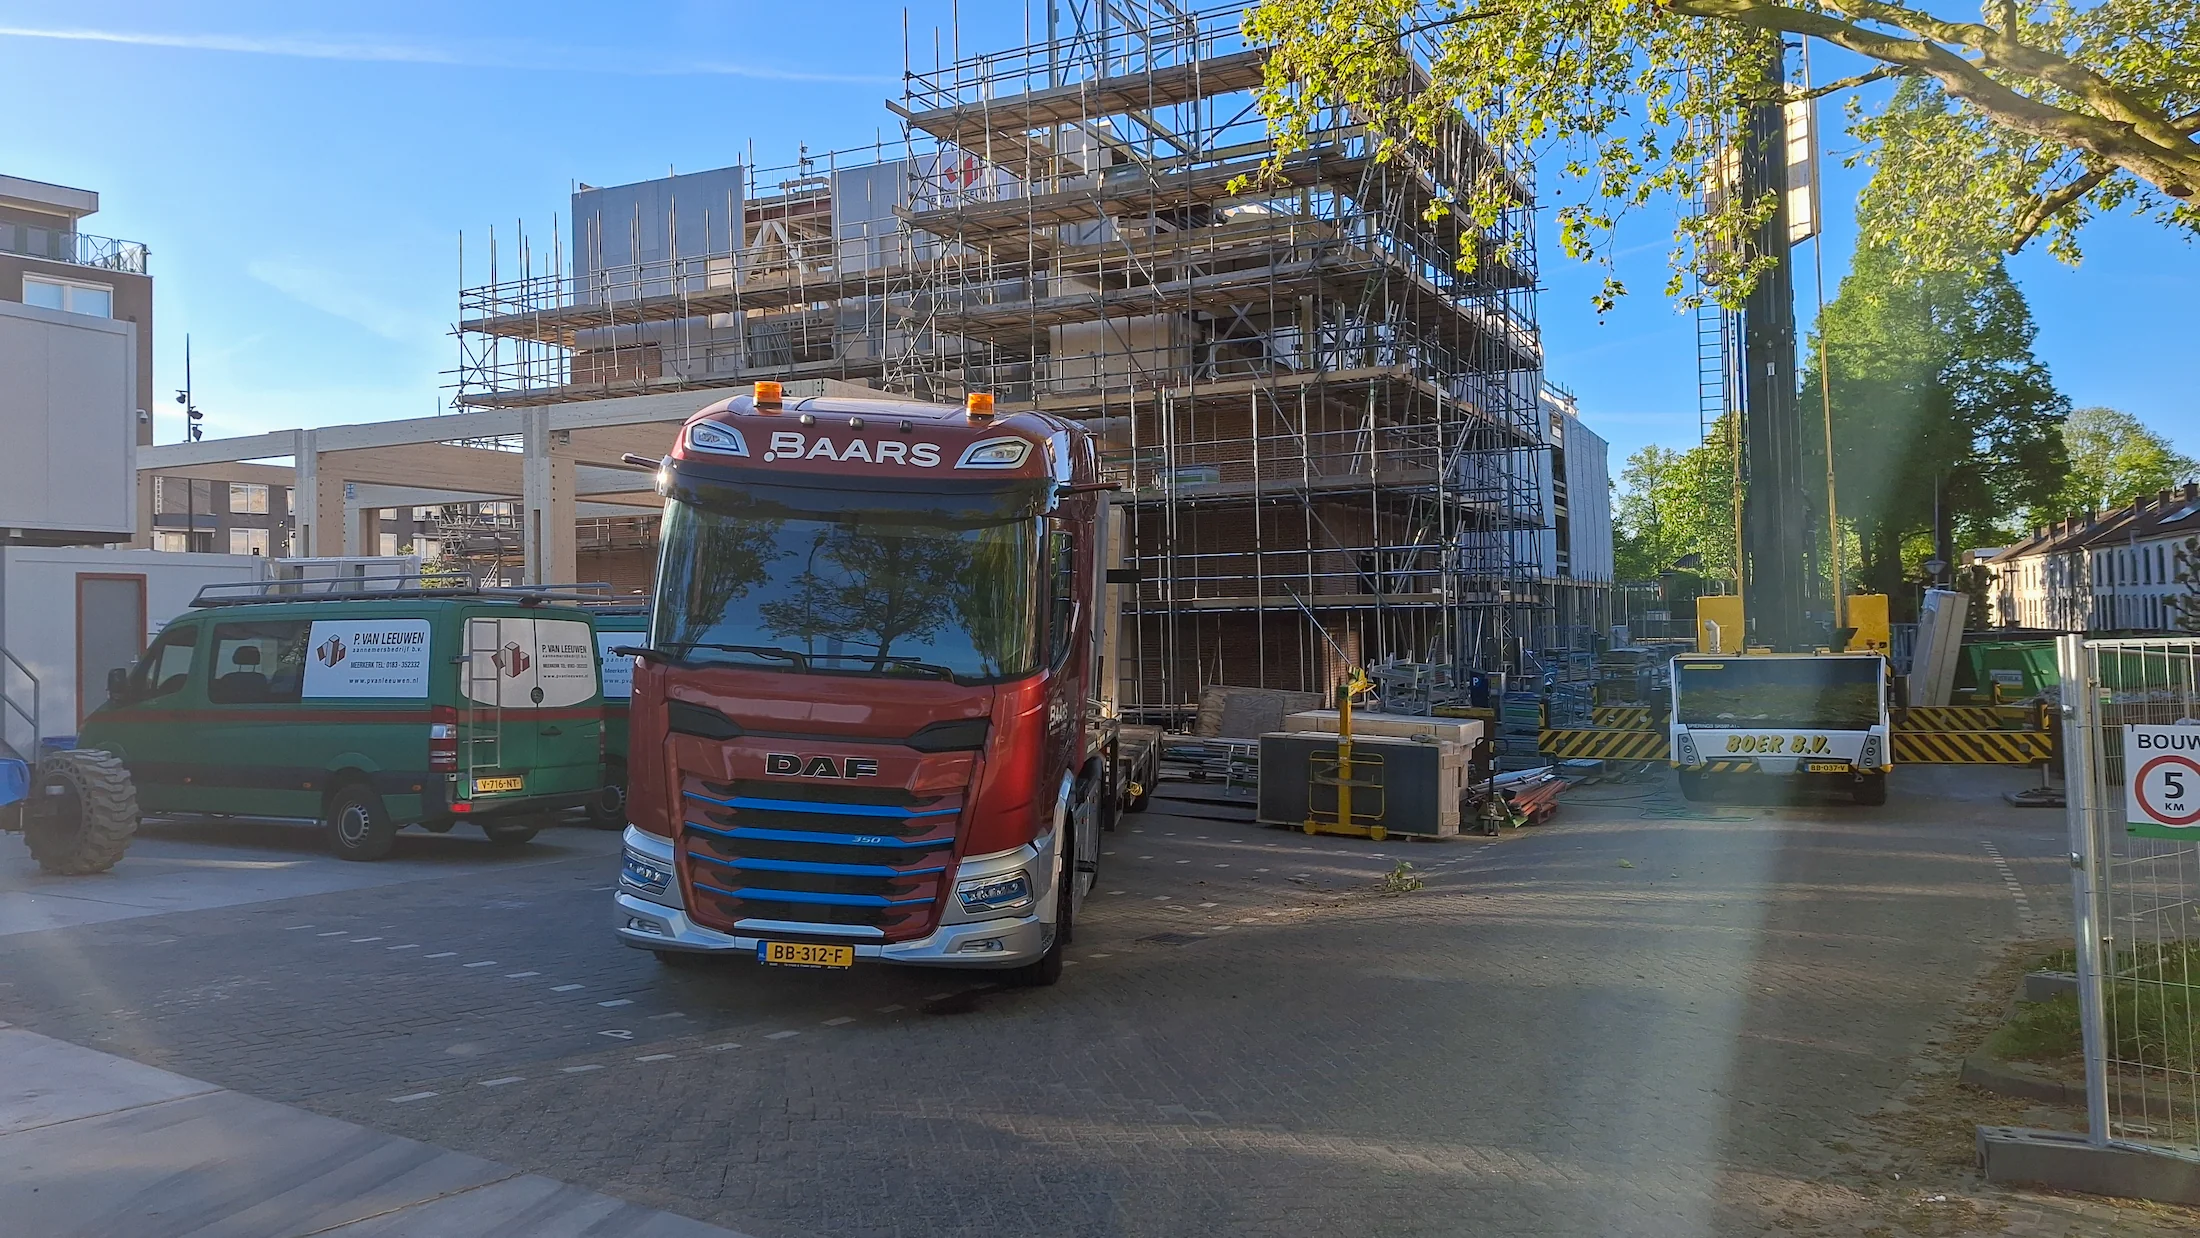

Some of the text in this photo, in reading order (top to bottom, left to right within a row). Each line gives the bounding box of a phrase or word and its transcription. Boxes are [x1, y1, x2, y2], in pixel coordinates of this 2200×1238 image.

[362, 632, 380, 645] VAN
[381, 631, 425, 645] LEEUWEN
[548, 644, 560, 653] VAN
[561, 644, 588, 654] LEEUWEN
[349, 677, 419, 685] www.pvanleeuwen.nl
[1472, 676, 1479, 687] P
[1726, 733, 1832, 755] BOER B.V.
[765, 752, 879, 780] DAF
[480, 778, 517, 790] V-716-NT
[2164, 771, 2185, 799] 5
[2164, 802, 2185, 812] KM
[852, 836, 881, 844] 350
[774, 944, 844, 963] BB-312-F
